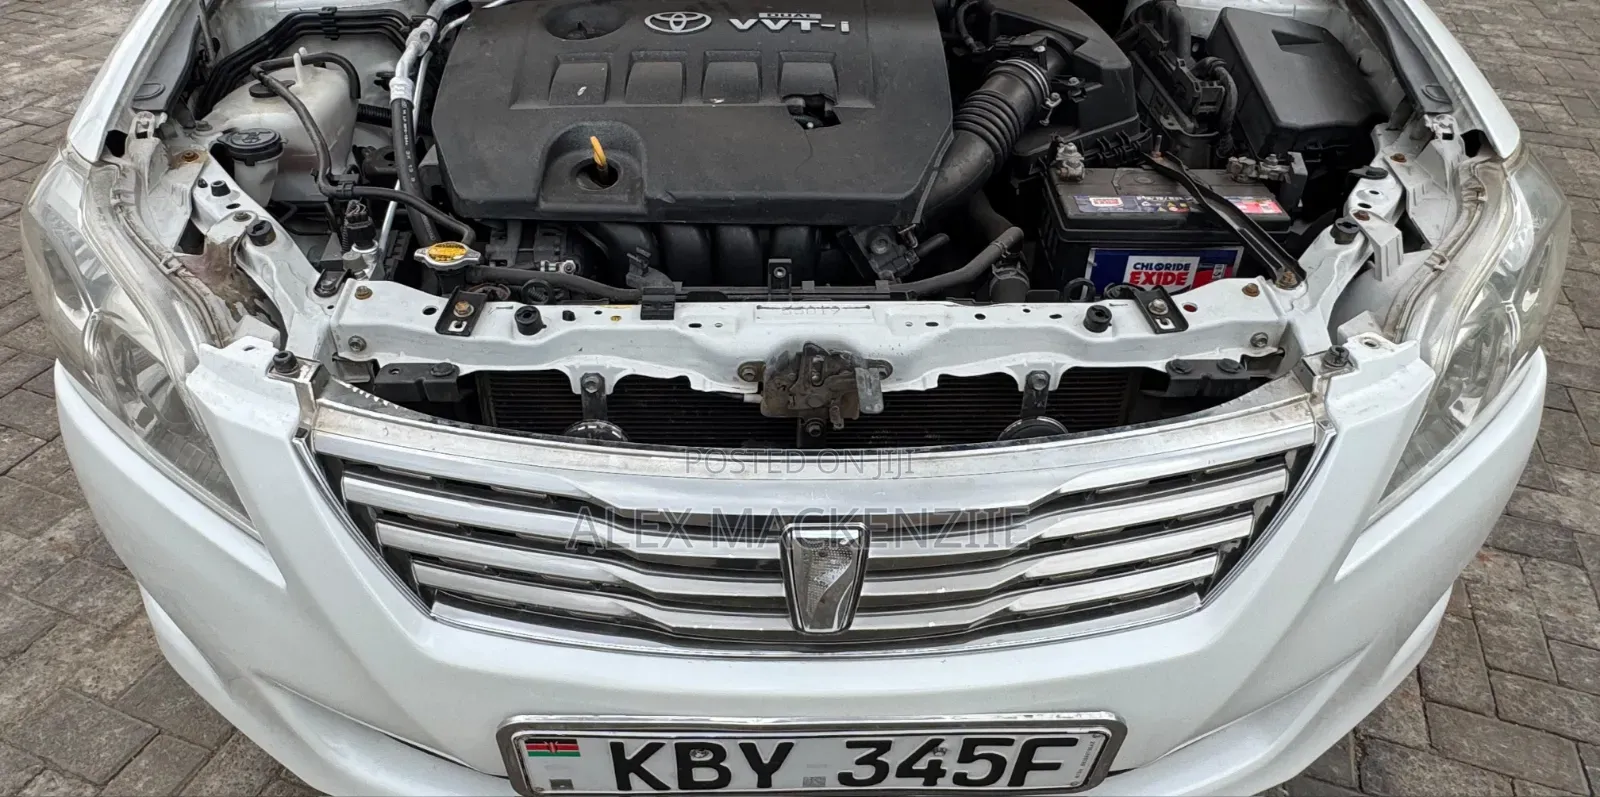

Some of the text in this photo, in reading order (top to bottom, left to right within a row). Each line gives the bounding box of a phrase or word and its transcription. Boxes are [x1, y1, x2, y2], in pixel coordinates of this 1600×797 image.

[728, 18, 850, 32] VVT-i
[1133, 262, 1191, 271] CHLORIDE
[1129, 271, 1189, 286] EXIDE
[609, 740, 795, 791] KBY
[837, 737, 1079, 788] 345F
